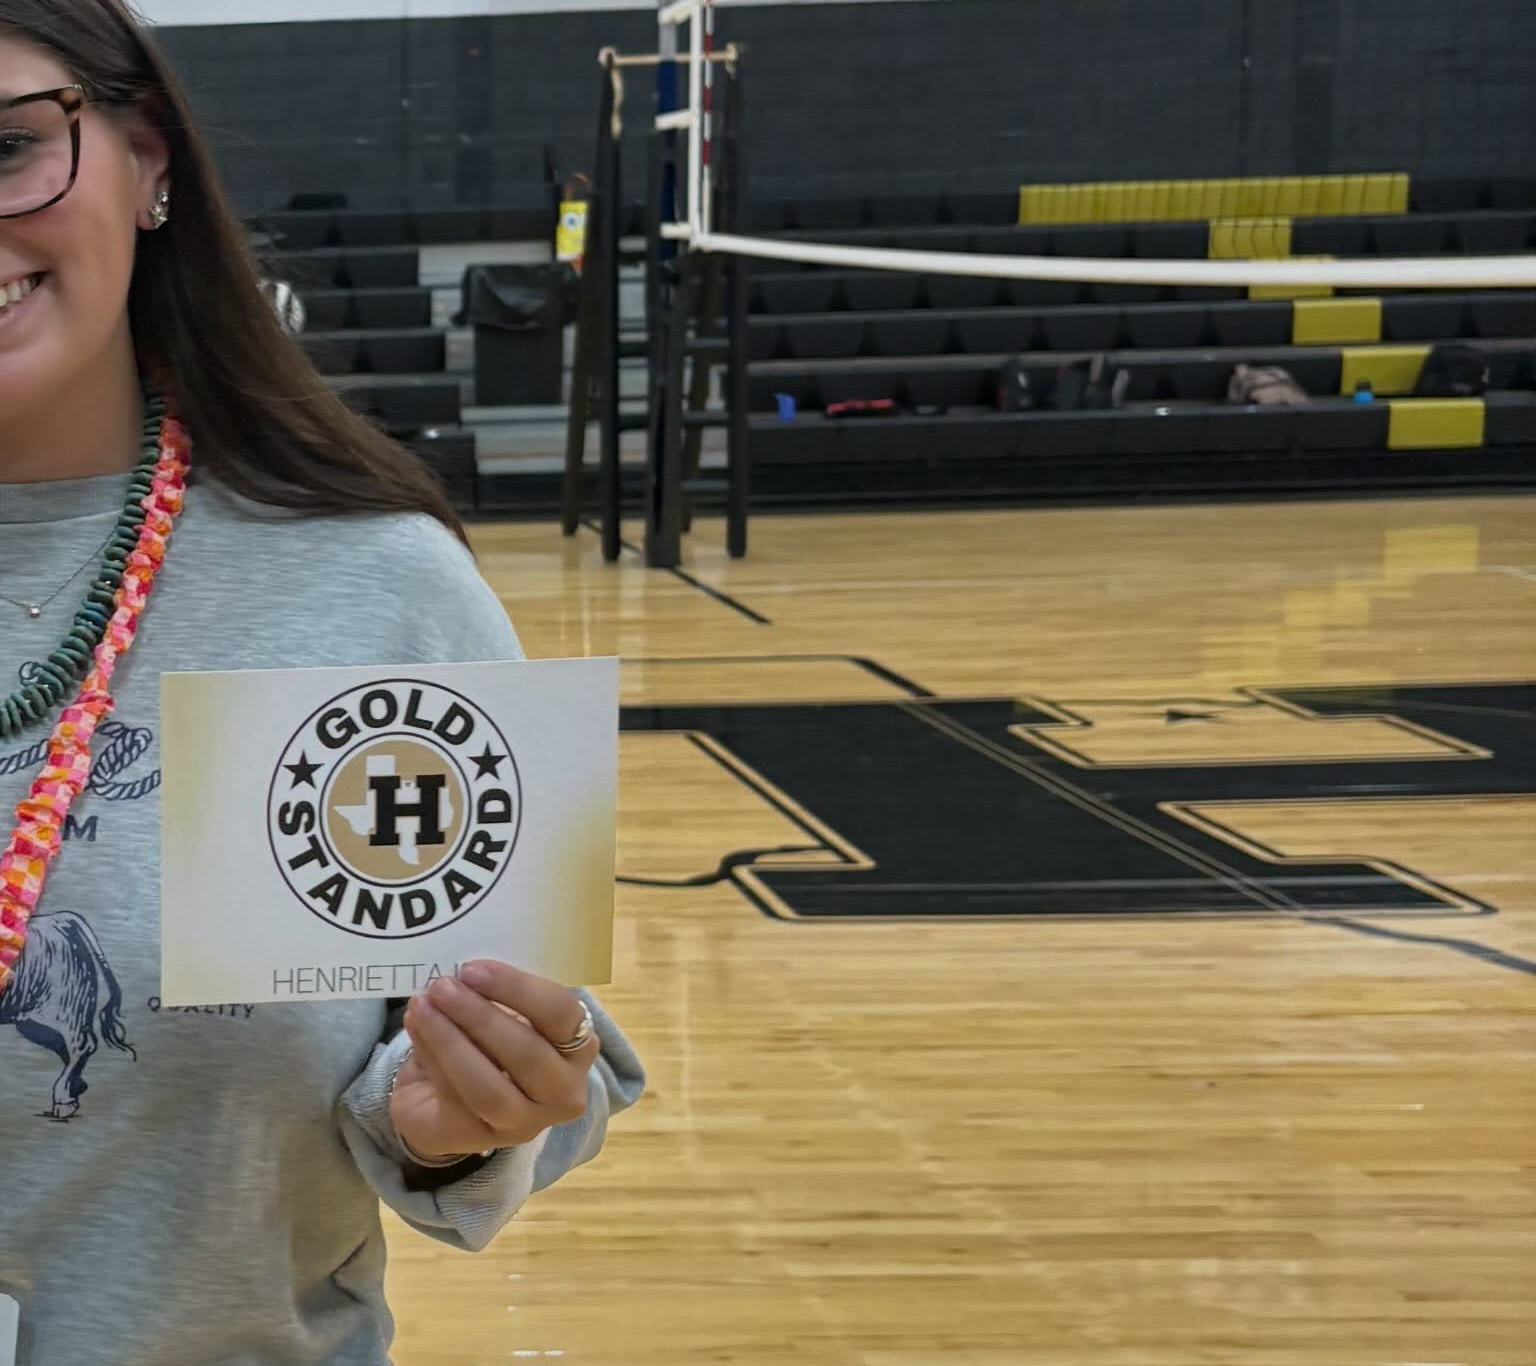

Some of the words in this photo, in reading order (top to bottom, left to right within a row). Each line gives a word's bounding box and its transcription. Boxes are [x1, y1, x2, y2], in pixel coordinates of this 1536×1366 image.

[315, 688, 476, 750] GOLD
[368, 773, 446, 847] H
[277, 786, 513, 931] STANDARD
[272, 963, 443, 996] HENRIETTA
